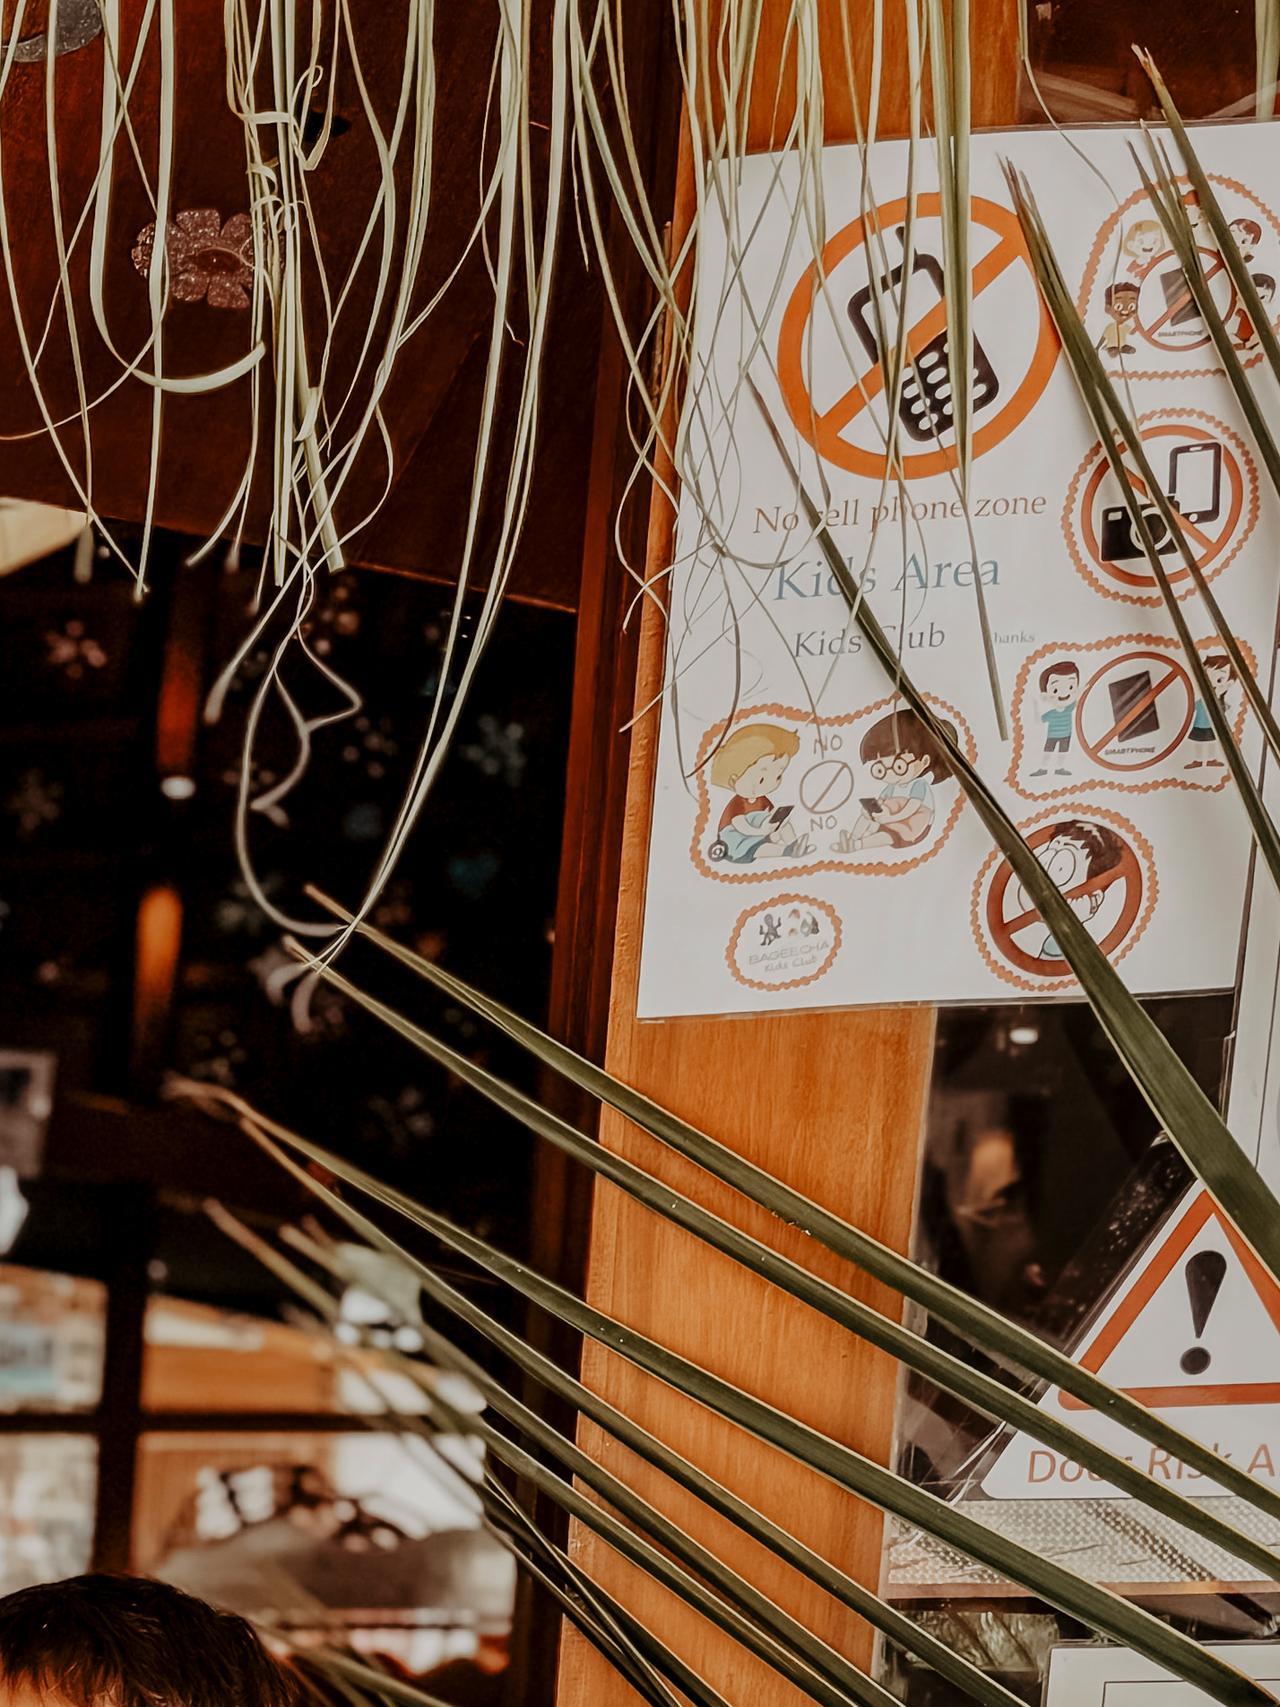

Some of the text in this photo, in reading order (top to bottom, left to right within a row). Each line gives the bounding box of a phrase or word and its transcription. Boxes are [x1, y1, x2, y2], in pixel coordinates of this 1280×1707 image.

[753, 506, 799, 534] No
[817, 498, 859, 528] ell
[974, 495, 1047, 518] zone
[891, 553, 1001, 592] Area
[794, 628, 863, 658] Kids
[992, 629, 1037, 645] hanks
[813, 734, 843, 754] NO
[810, 815, 838, 832] NO
